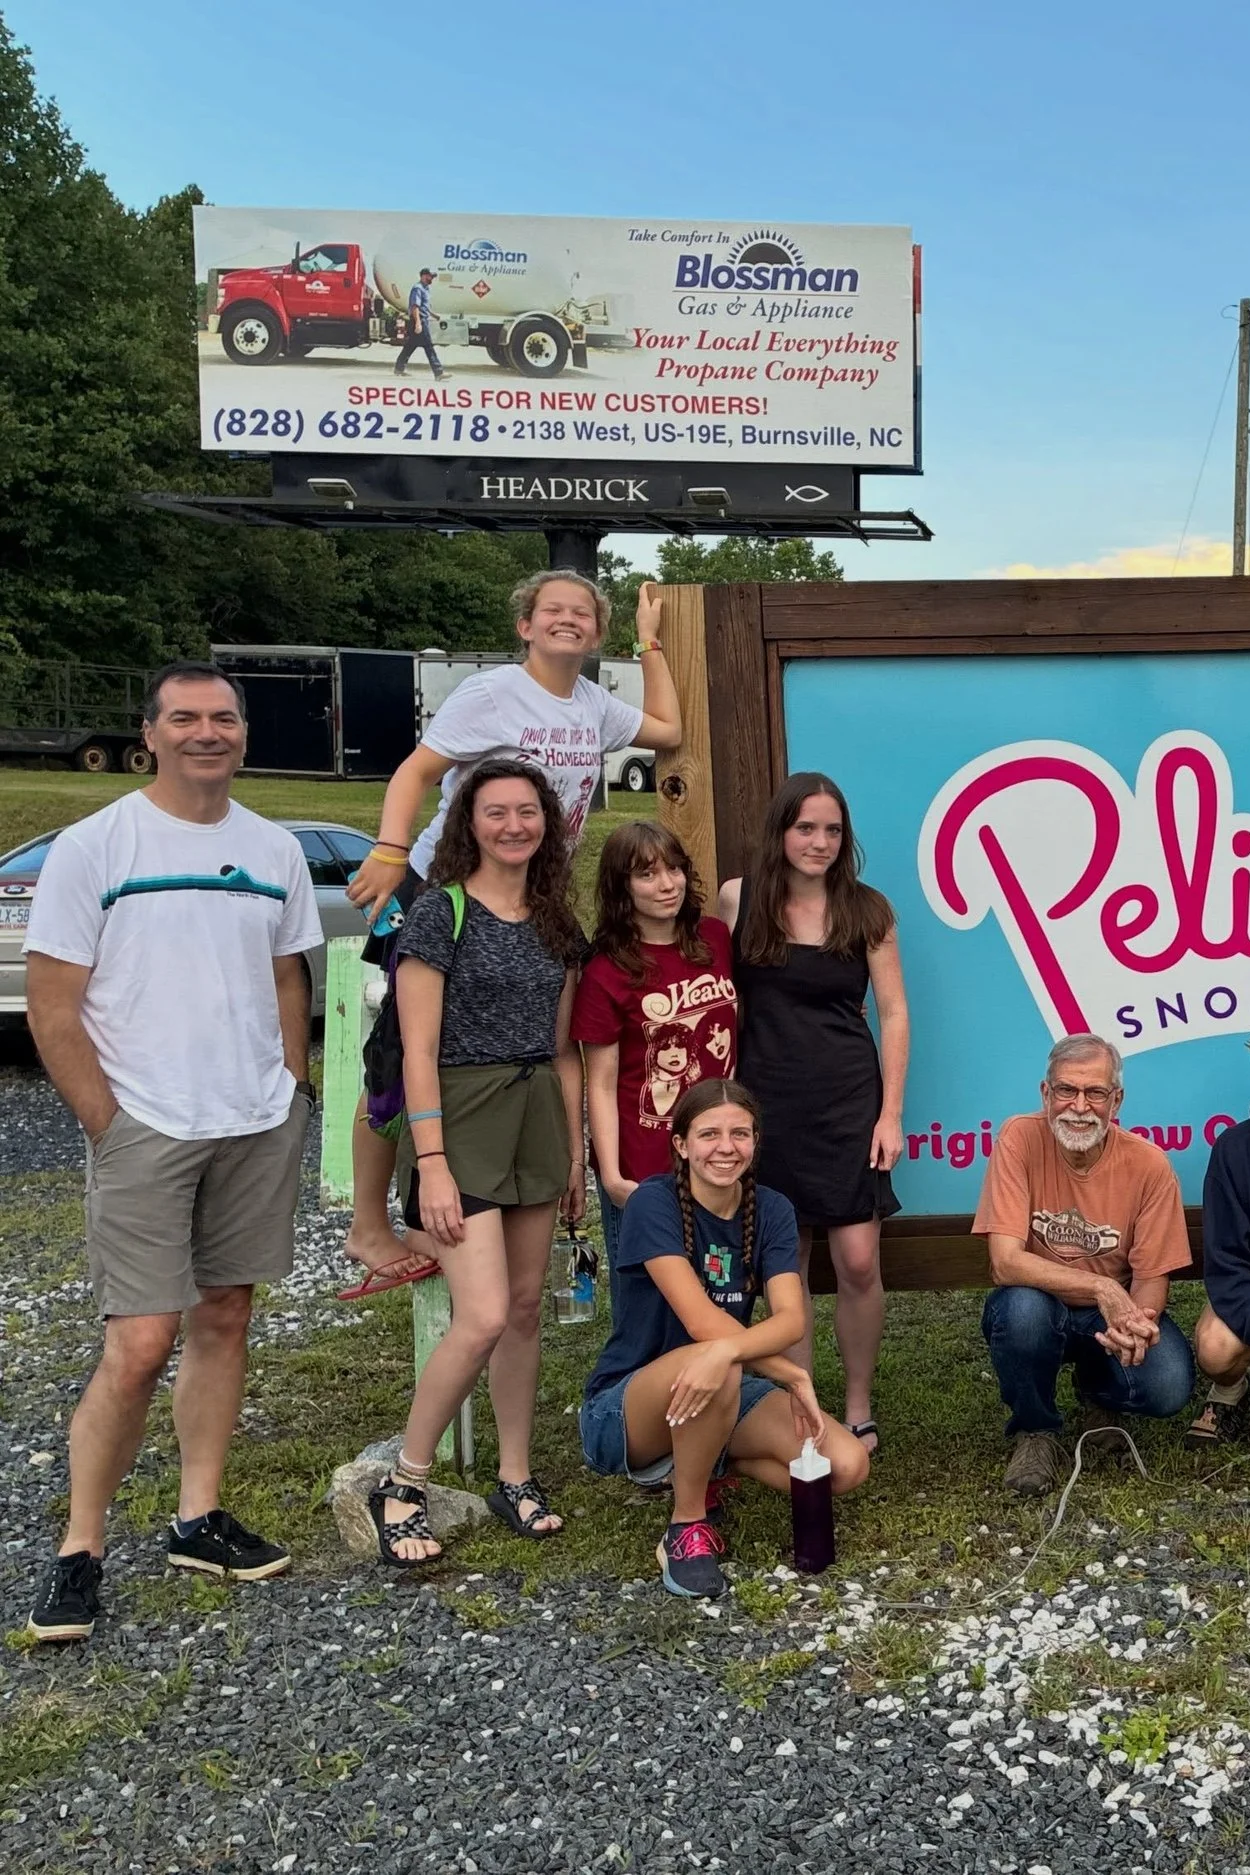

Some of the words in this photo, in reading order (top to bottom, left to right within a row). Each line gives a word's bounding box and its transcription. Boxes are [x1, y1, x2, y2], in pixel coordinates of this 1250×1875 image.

[628, 228, 657, 242] Take
[661, 230, 713, 247] Comfort
[716, 232, 730, 244] In
[444, 244, 527, 263] Blossman
[447, 262, 465, 272] Gas
[481, 264, 526, 276] Appliance
[675, 254, 858, 292] Blossman
[678, 295, 717, 315] Gas
[726, 296, 747, 315] &
[752, 298, 854, 323] Appliance
[632, 328, 690, 350] Your
[695, 330, 762, 351] Local
[765, 331, 900, 362] Everything
[655, 358, 757, 387] Propane
[765, 360, 879, 390] Company
[348, 386, 472, 408] SPECIALS
[481, 390, 531, 410] FOR
[541, 392, 597, 411] NEW
[604, 394, 768, 415] CUSTOMERS!
[214, 408, 304, 443] (828)
[318, 411, 489, 442] 682-2118
[512, 420, 566, 441] 2138
[573, 421, 636, 445] West,
[644, 422, 733, 448] US-19E,
[741, 425, 862, 449] Burnsville,
[869, 428, 903, 447] NC
[480, 477, 649, 502] HEADRICK
[641, 974, 737, 1022] Heart
[1048, 1223, 1098, 1243] COLONIAL
